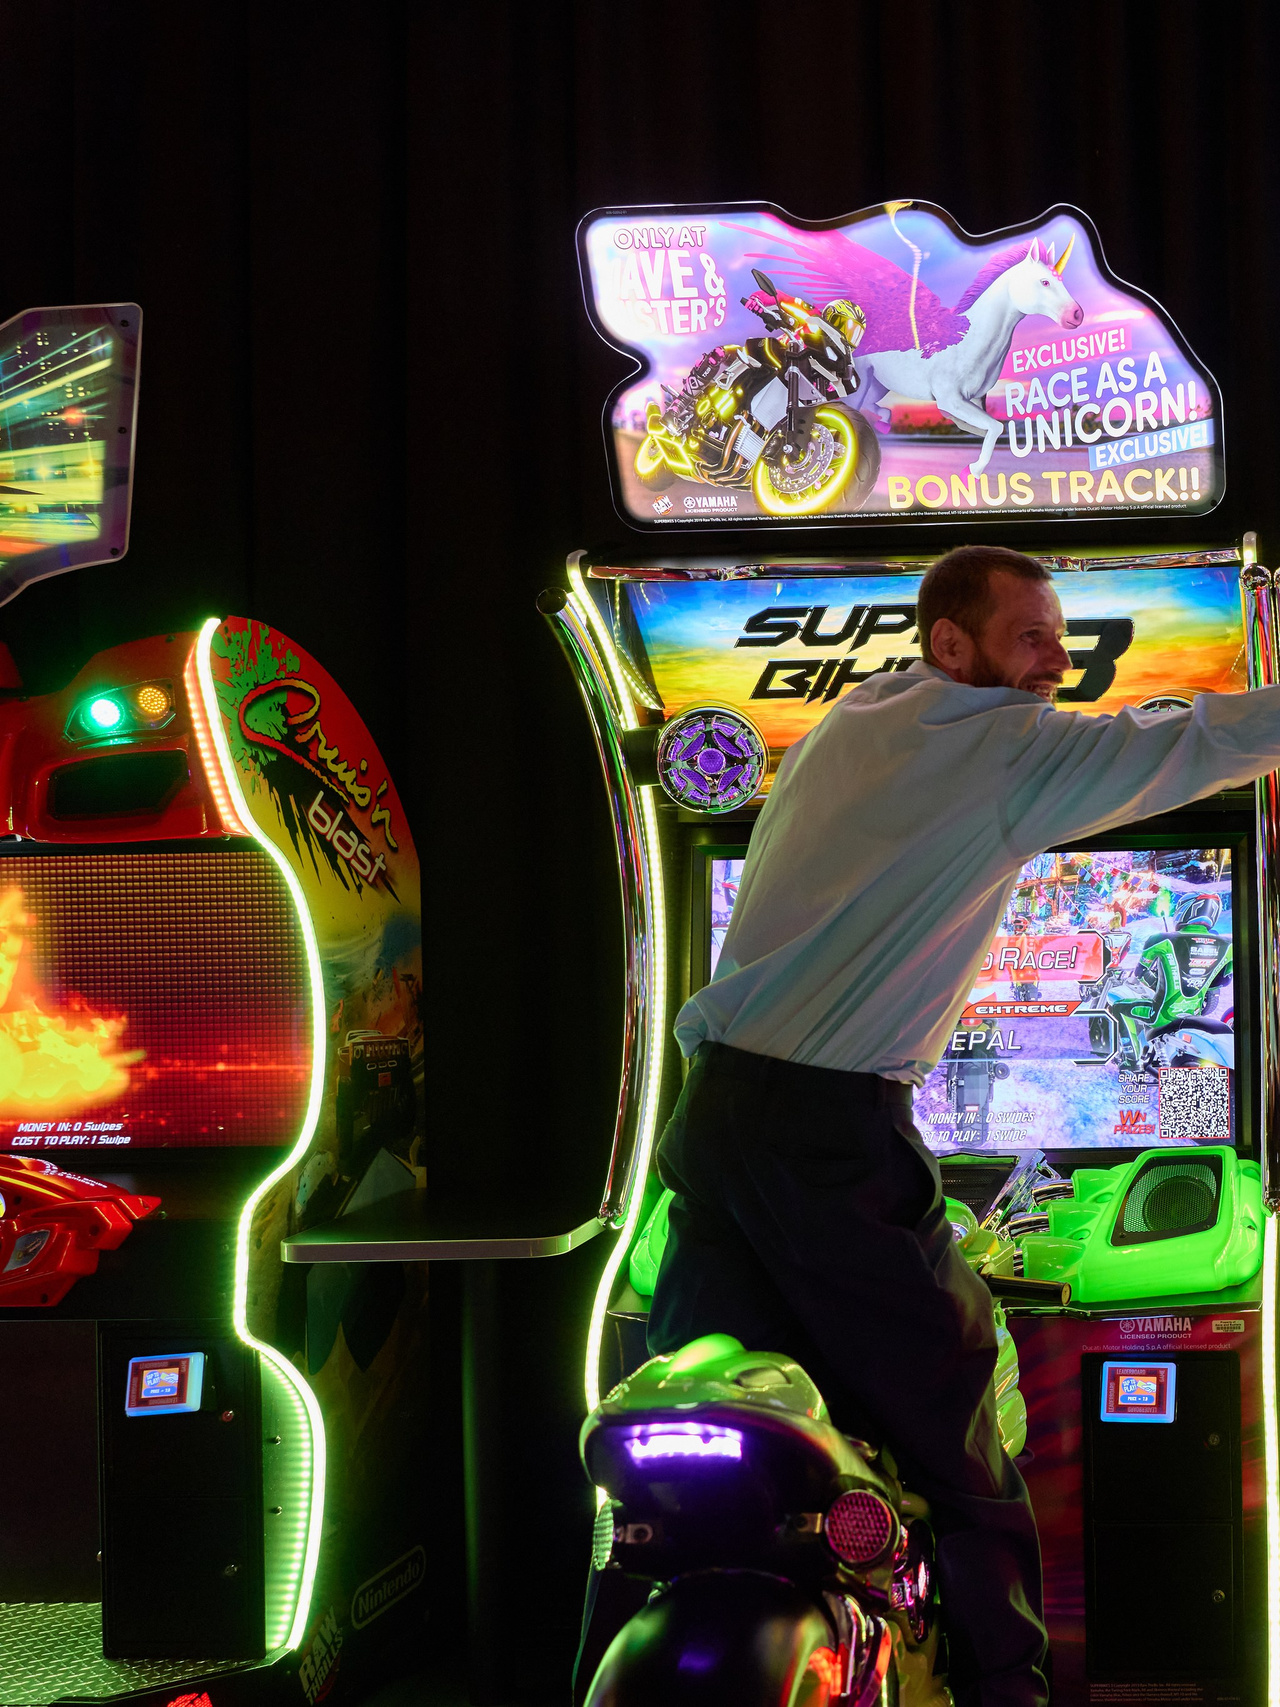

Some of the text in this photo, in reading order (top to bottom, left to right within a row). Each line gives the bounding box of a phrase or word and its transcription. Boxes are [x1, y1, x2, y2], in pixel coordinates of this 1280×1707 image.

[613, 226, 706, 250] ONLY AT
[607, 250, 727, 300] AVE &
[617, 296, 727, 335] STER'S
[1012, 328, 1127, 373] EXCLUSIVE!
[1005, 351, 1168, 418] RACE AS A
[1007, 380, 1199, 459] UNICORN!
[1095, 422, 1209, 468] EXCLUSIVE!
[887, 467, 1201, 510] BONUS TRACK!!
[695, 496, 738, 508] YAMAHA
[734, 603, 919, 653] SUP
[749, 616, 1136, 705] BIK 3
[307, 790, 388, 887] blast
[974, 1003, 1069, 1015] EXTREME
[951, 1030, 1022, 1052] EPAL
[1118, 1073, 1151, 1084] SHARE
[1121, 1084, 1148, 1094] YOUR
[1118, 1094, 1150, 1104] SCORE
[18, 1122, 56, 1132] MONEY
[56, 1122, 72, 1132] IN:
[82, 1122, 124, 1132] Swipes
[927, 1112, 964, 1124] MONEY
[995, 1110, 1036, 1126] swipes
[1114, 1124, 1156, 1136] PRIZES!
[12, 1134, 132, 1146] COST TO PLAY: 1 Swipe
[937, 1130, 950, 1143] TO
[986, 1131, 991, 1142] 1
[993, 1128, 1028, 1143] swipe
[1136, 1317, 1192, 1332] YAMAHA
[358, 1562, 420, 1618] Nintendo
[298, 1606, 338, 1694] RAW
